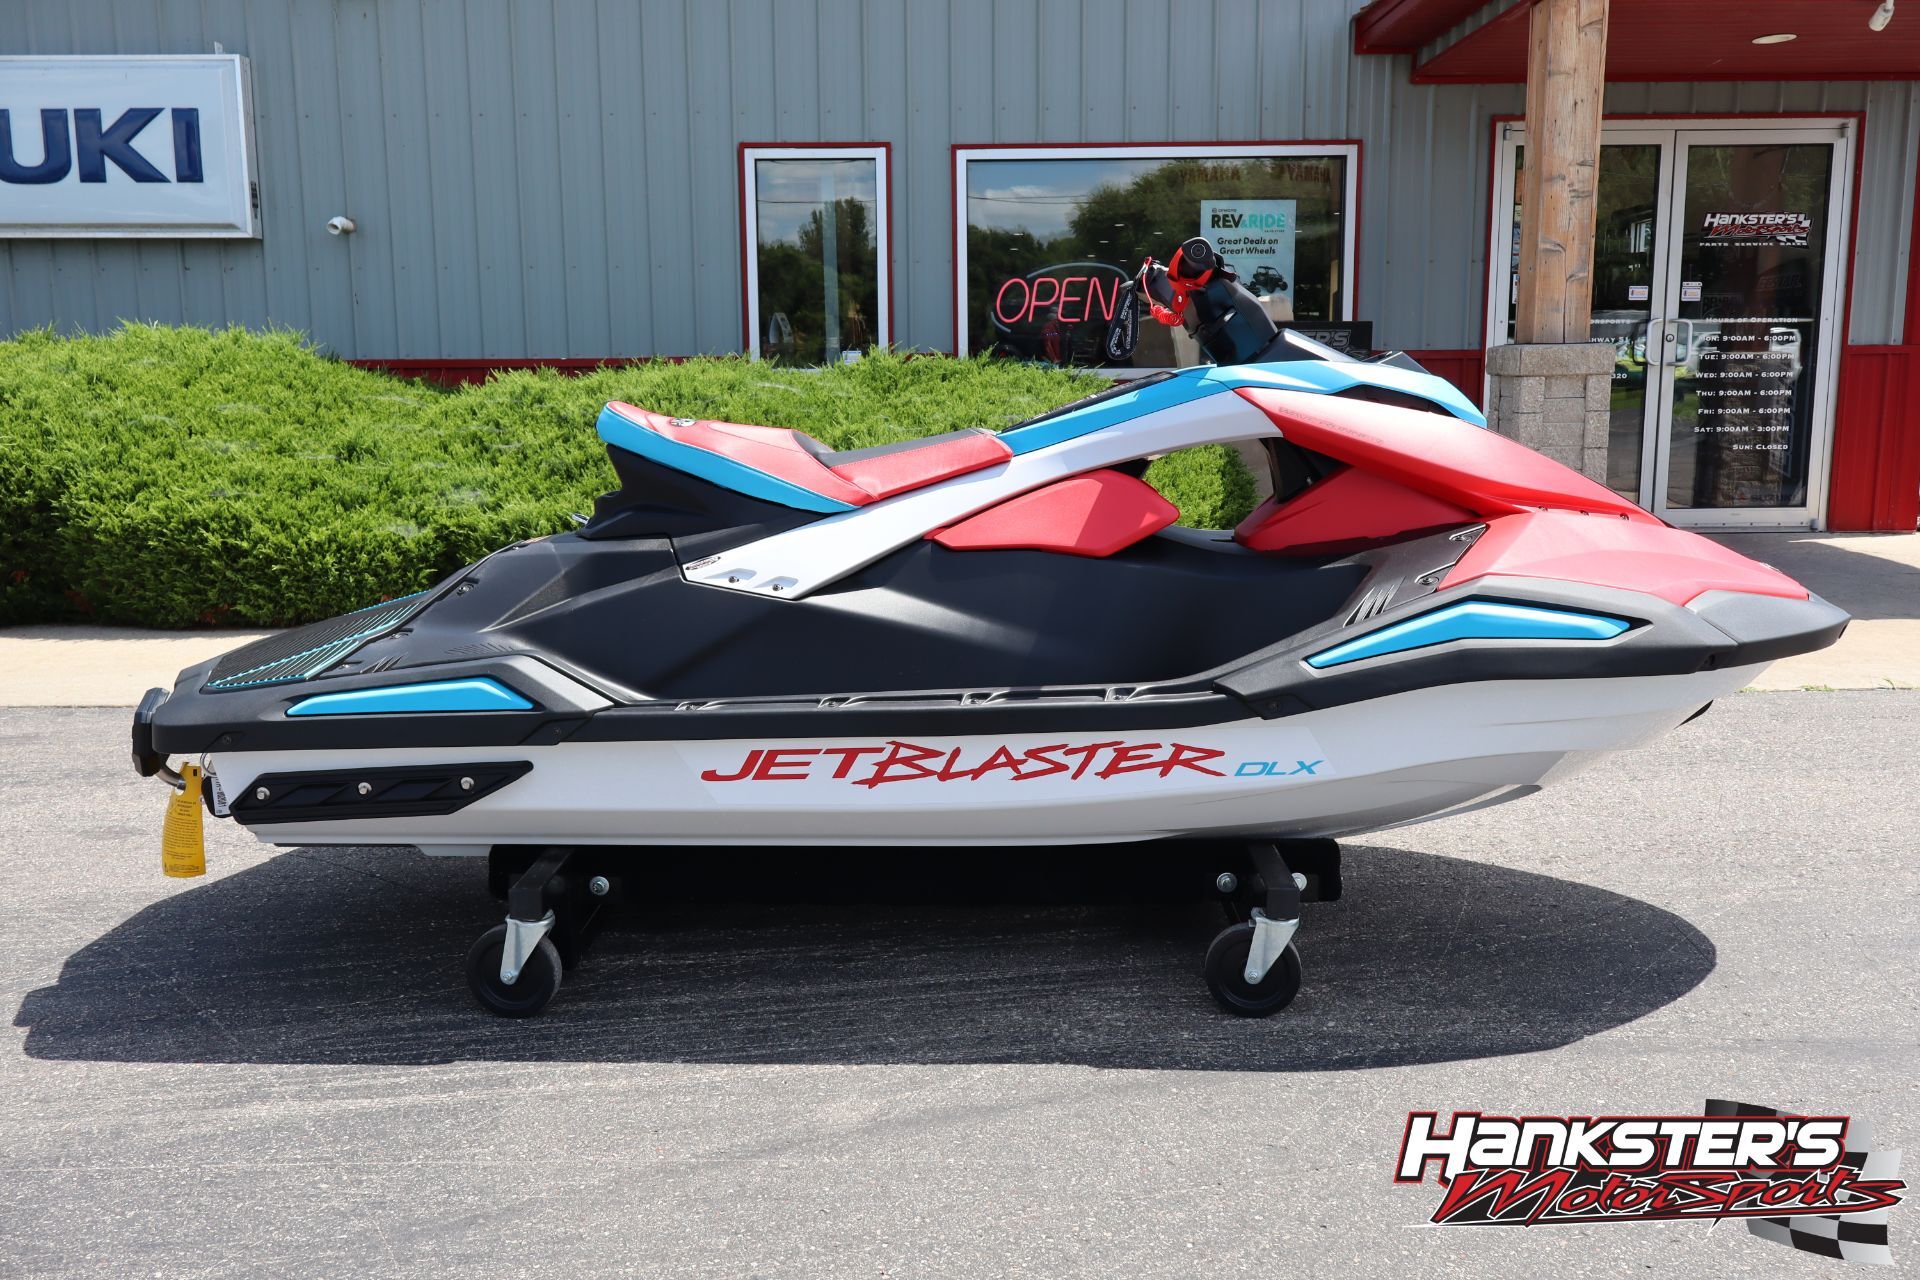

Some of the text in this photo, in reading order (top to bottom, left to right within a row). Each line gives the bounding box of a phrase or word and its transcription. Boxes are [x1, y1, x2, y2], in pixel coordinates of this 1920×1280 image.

[1217, 237, 1242, 245] Great
[1243, 237, 1266, 245] Deals
[1220, 247, 1276, 255] Great Wheels
[996, 276, 1119, 323] OPEN
[700, 740, 1325, 790] JETBLASTER DLX
